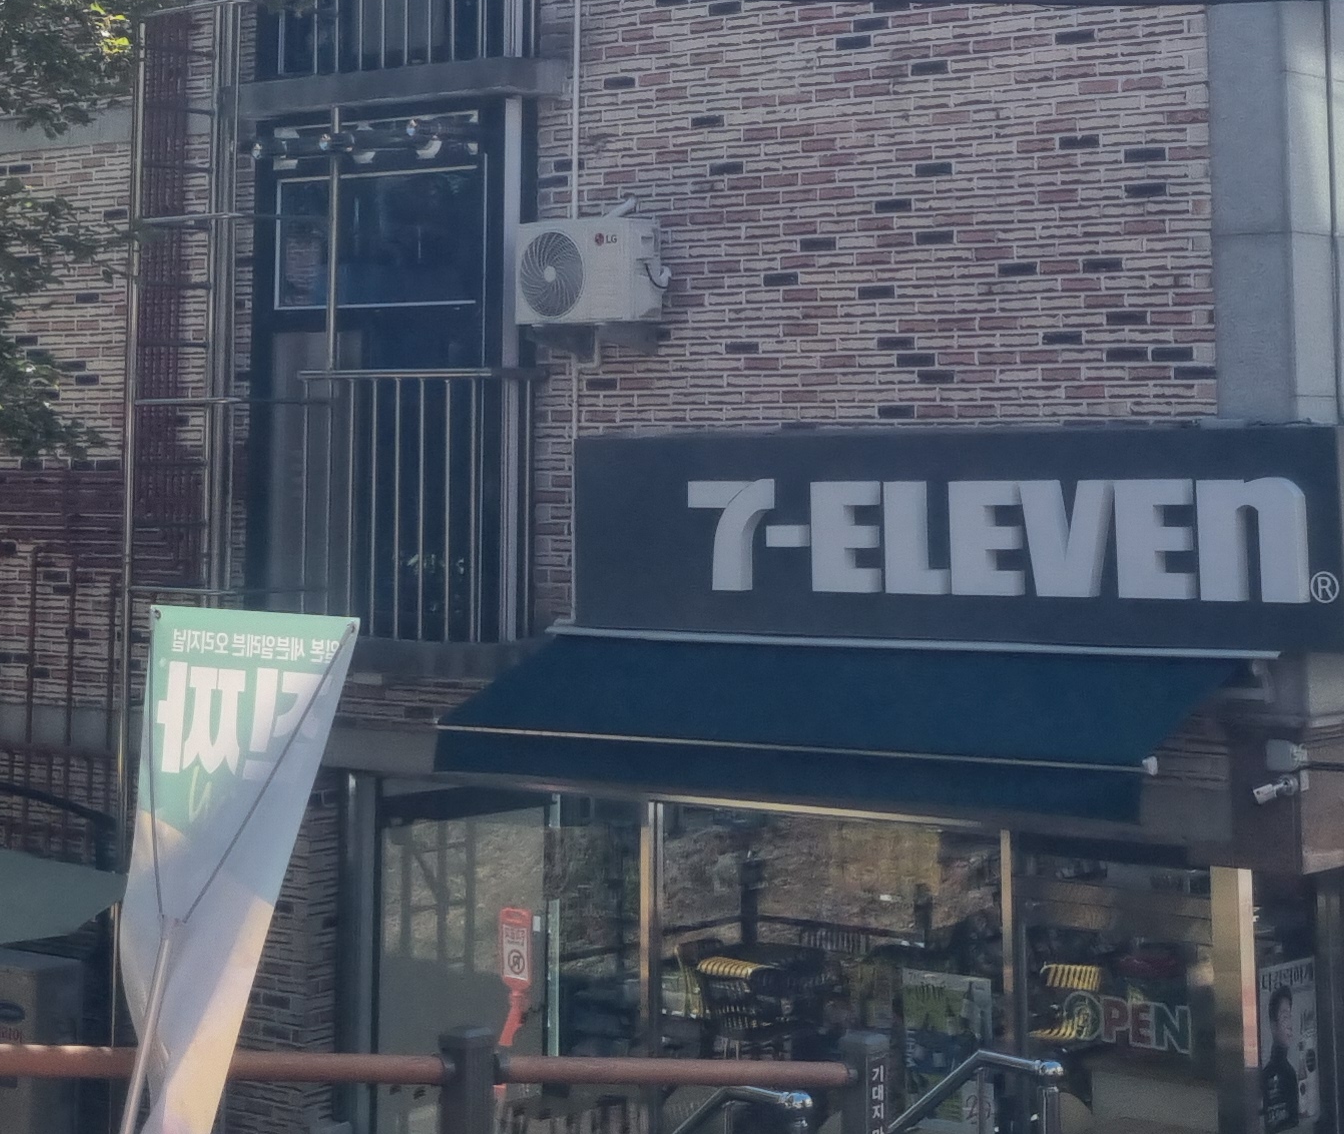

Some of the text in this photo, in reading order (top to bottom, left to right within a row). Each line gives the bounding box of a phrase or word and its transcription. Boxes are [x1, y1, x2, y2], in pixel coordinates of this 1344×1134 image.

[605, 234, 618, 244] LG
[1063, 990, 1192, 1056] OPEN
[871, 1065, 884, 1120] 기대지
